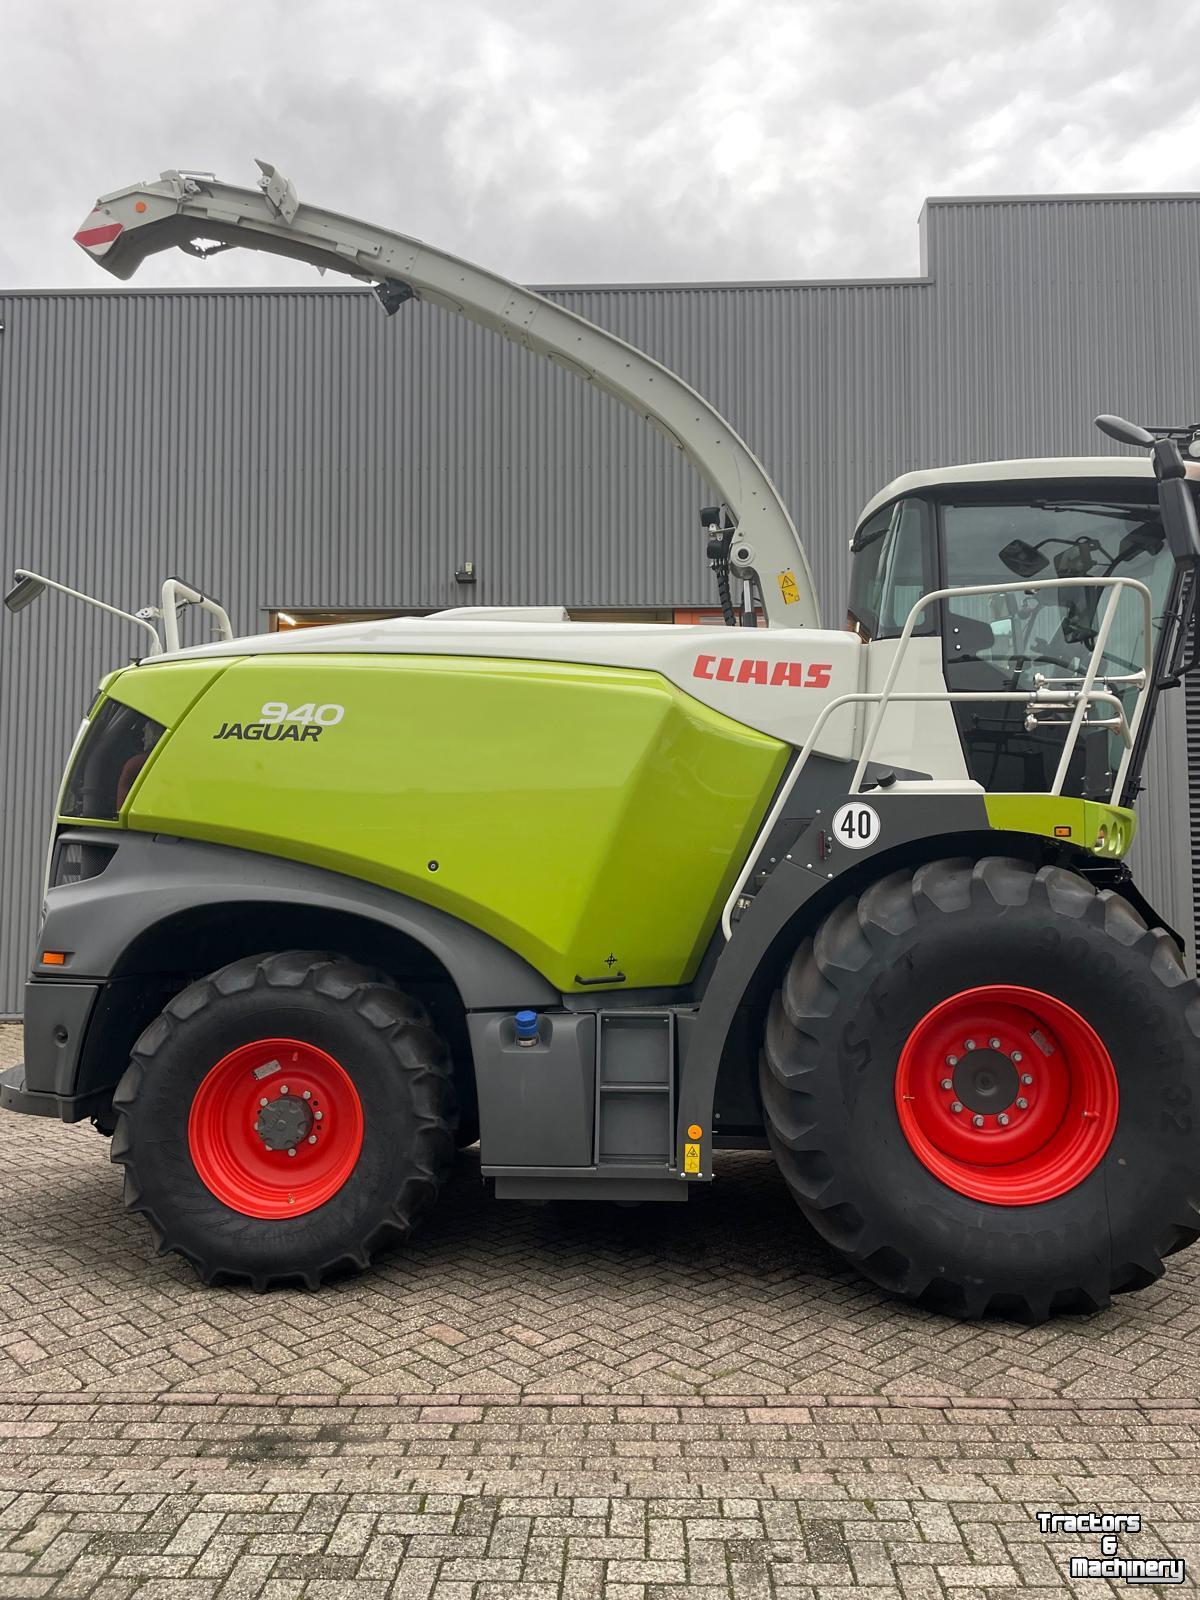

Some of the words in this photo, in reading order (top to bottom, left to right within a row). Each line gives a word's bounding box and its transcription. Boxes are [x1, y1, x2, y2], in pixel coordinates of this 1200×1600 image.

[693, 654, 832, 689] CLAAS
[259, 702, 345, 726] 940
[213, 723, 323, 742] JAGUAR
[840, 810, 871, 839] 40
